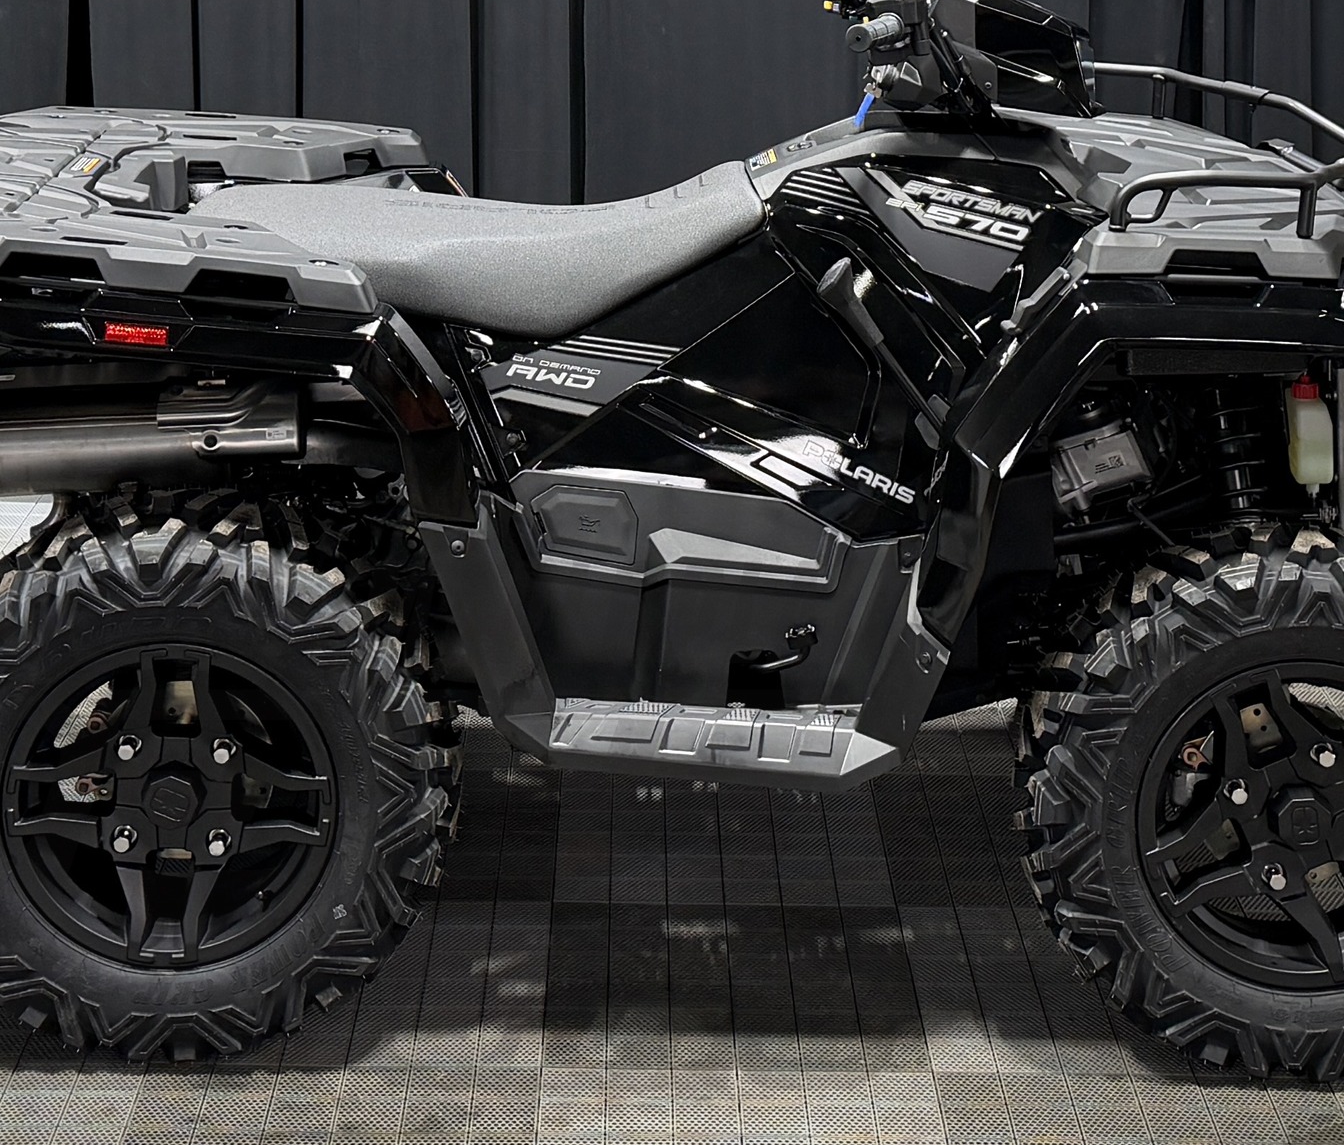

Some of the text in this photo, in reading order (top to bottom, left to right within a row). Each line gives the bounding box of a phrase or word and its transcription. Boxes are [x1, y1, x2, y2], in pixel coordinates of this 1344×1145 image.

[901, 180, 1045, 224] SPORTSMAN
[922, 203, 1030, 242] 570
[506, 363, 596, 390] AWD
[539, 358, 602, 375] DEMAND
[802, 439, 916, 505] POLARIS
